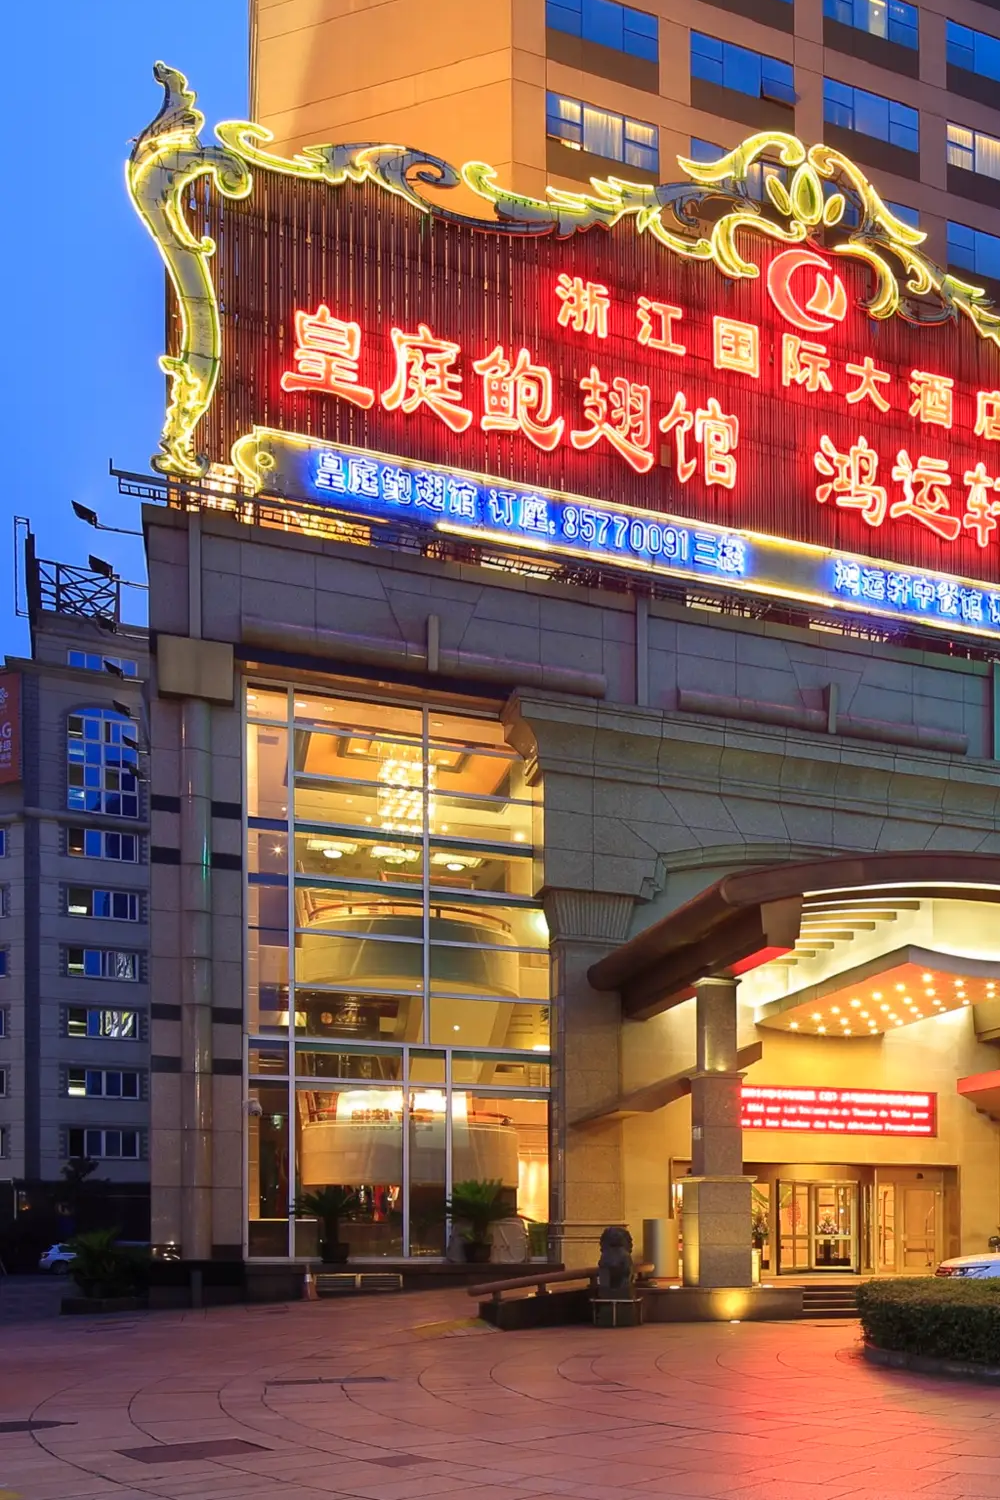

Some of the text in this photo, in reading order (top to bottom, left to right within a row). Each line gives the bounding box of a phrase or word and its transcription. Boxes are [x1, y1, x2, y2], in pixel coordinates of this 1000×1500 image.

[281, 304, 739, 490] 皇庭鲍翅馆
[315, 452, 477, 518] 皇庭鲍翅馆
[835, 561, 984, 624] 鸿运轩中餐馆
